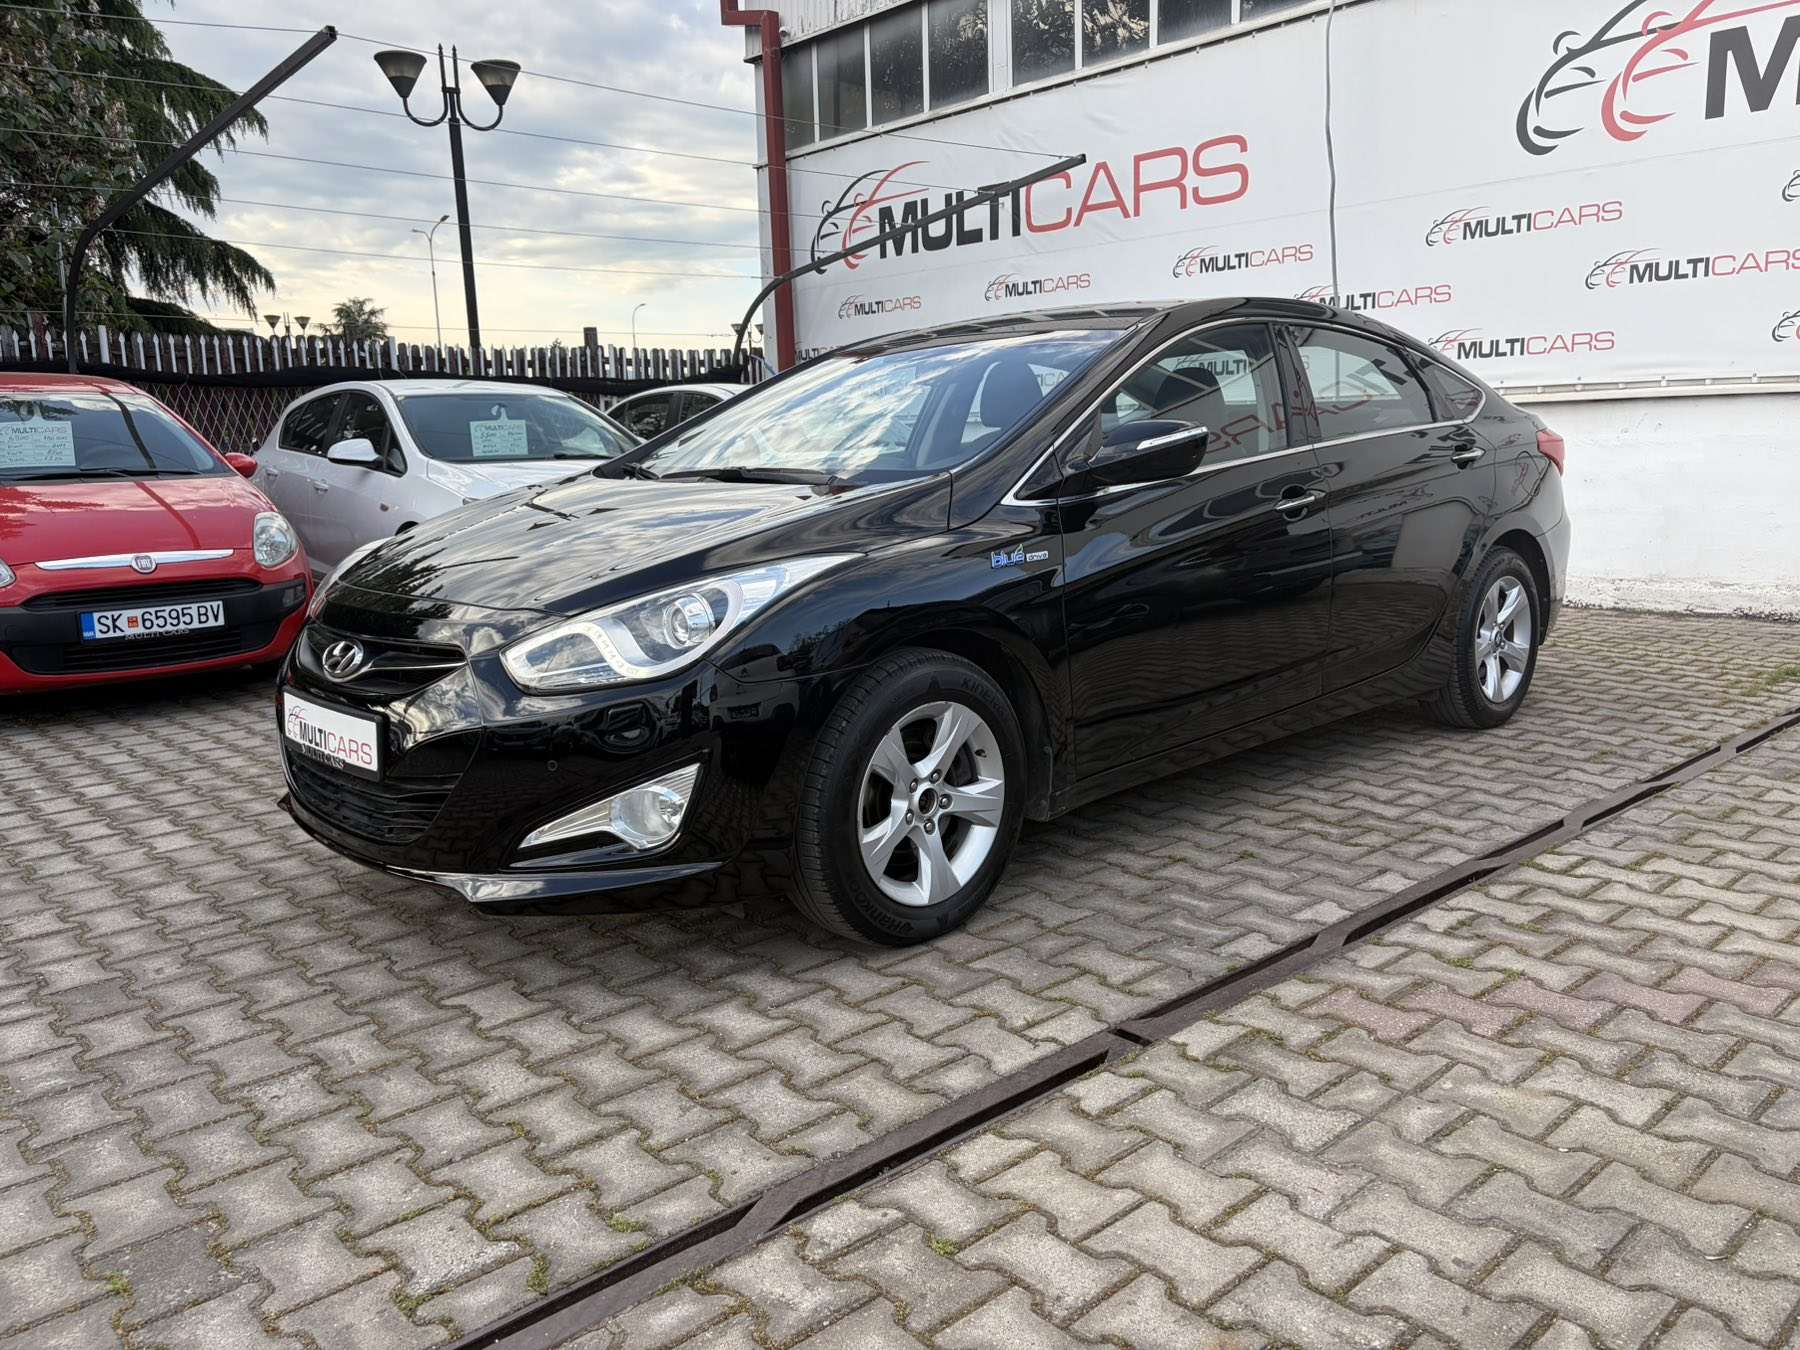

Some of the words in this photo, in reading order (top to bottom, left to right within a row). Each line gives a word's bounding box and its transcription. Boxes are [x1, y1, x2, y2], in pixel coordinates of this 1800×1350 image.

[878, 134, 1249, 259] MULTICARS
[1462, 200, 1623, 241] MULTICARS
[1199, 244, 1314, 274] MULTICARS
[1004, 273, 1091, 299] MULTICARS
[853, 296, 922, 316] MULTICARS
[1457, 331, 1615, 360] MULTICARS
[991, 544, 1024, 568] blue
[97, 613, 125, 635] SK
[141, 606, 193, 630] 6595
[197, 603, 221, 625] BV
[299, 720, 373, 766] MULTICARS
